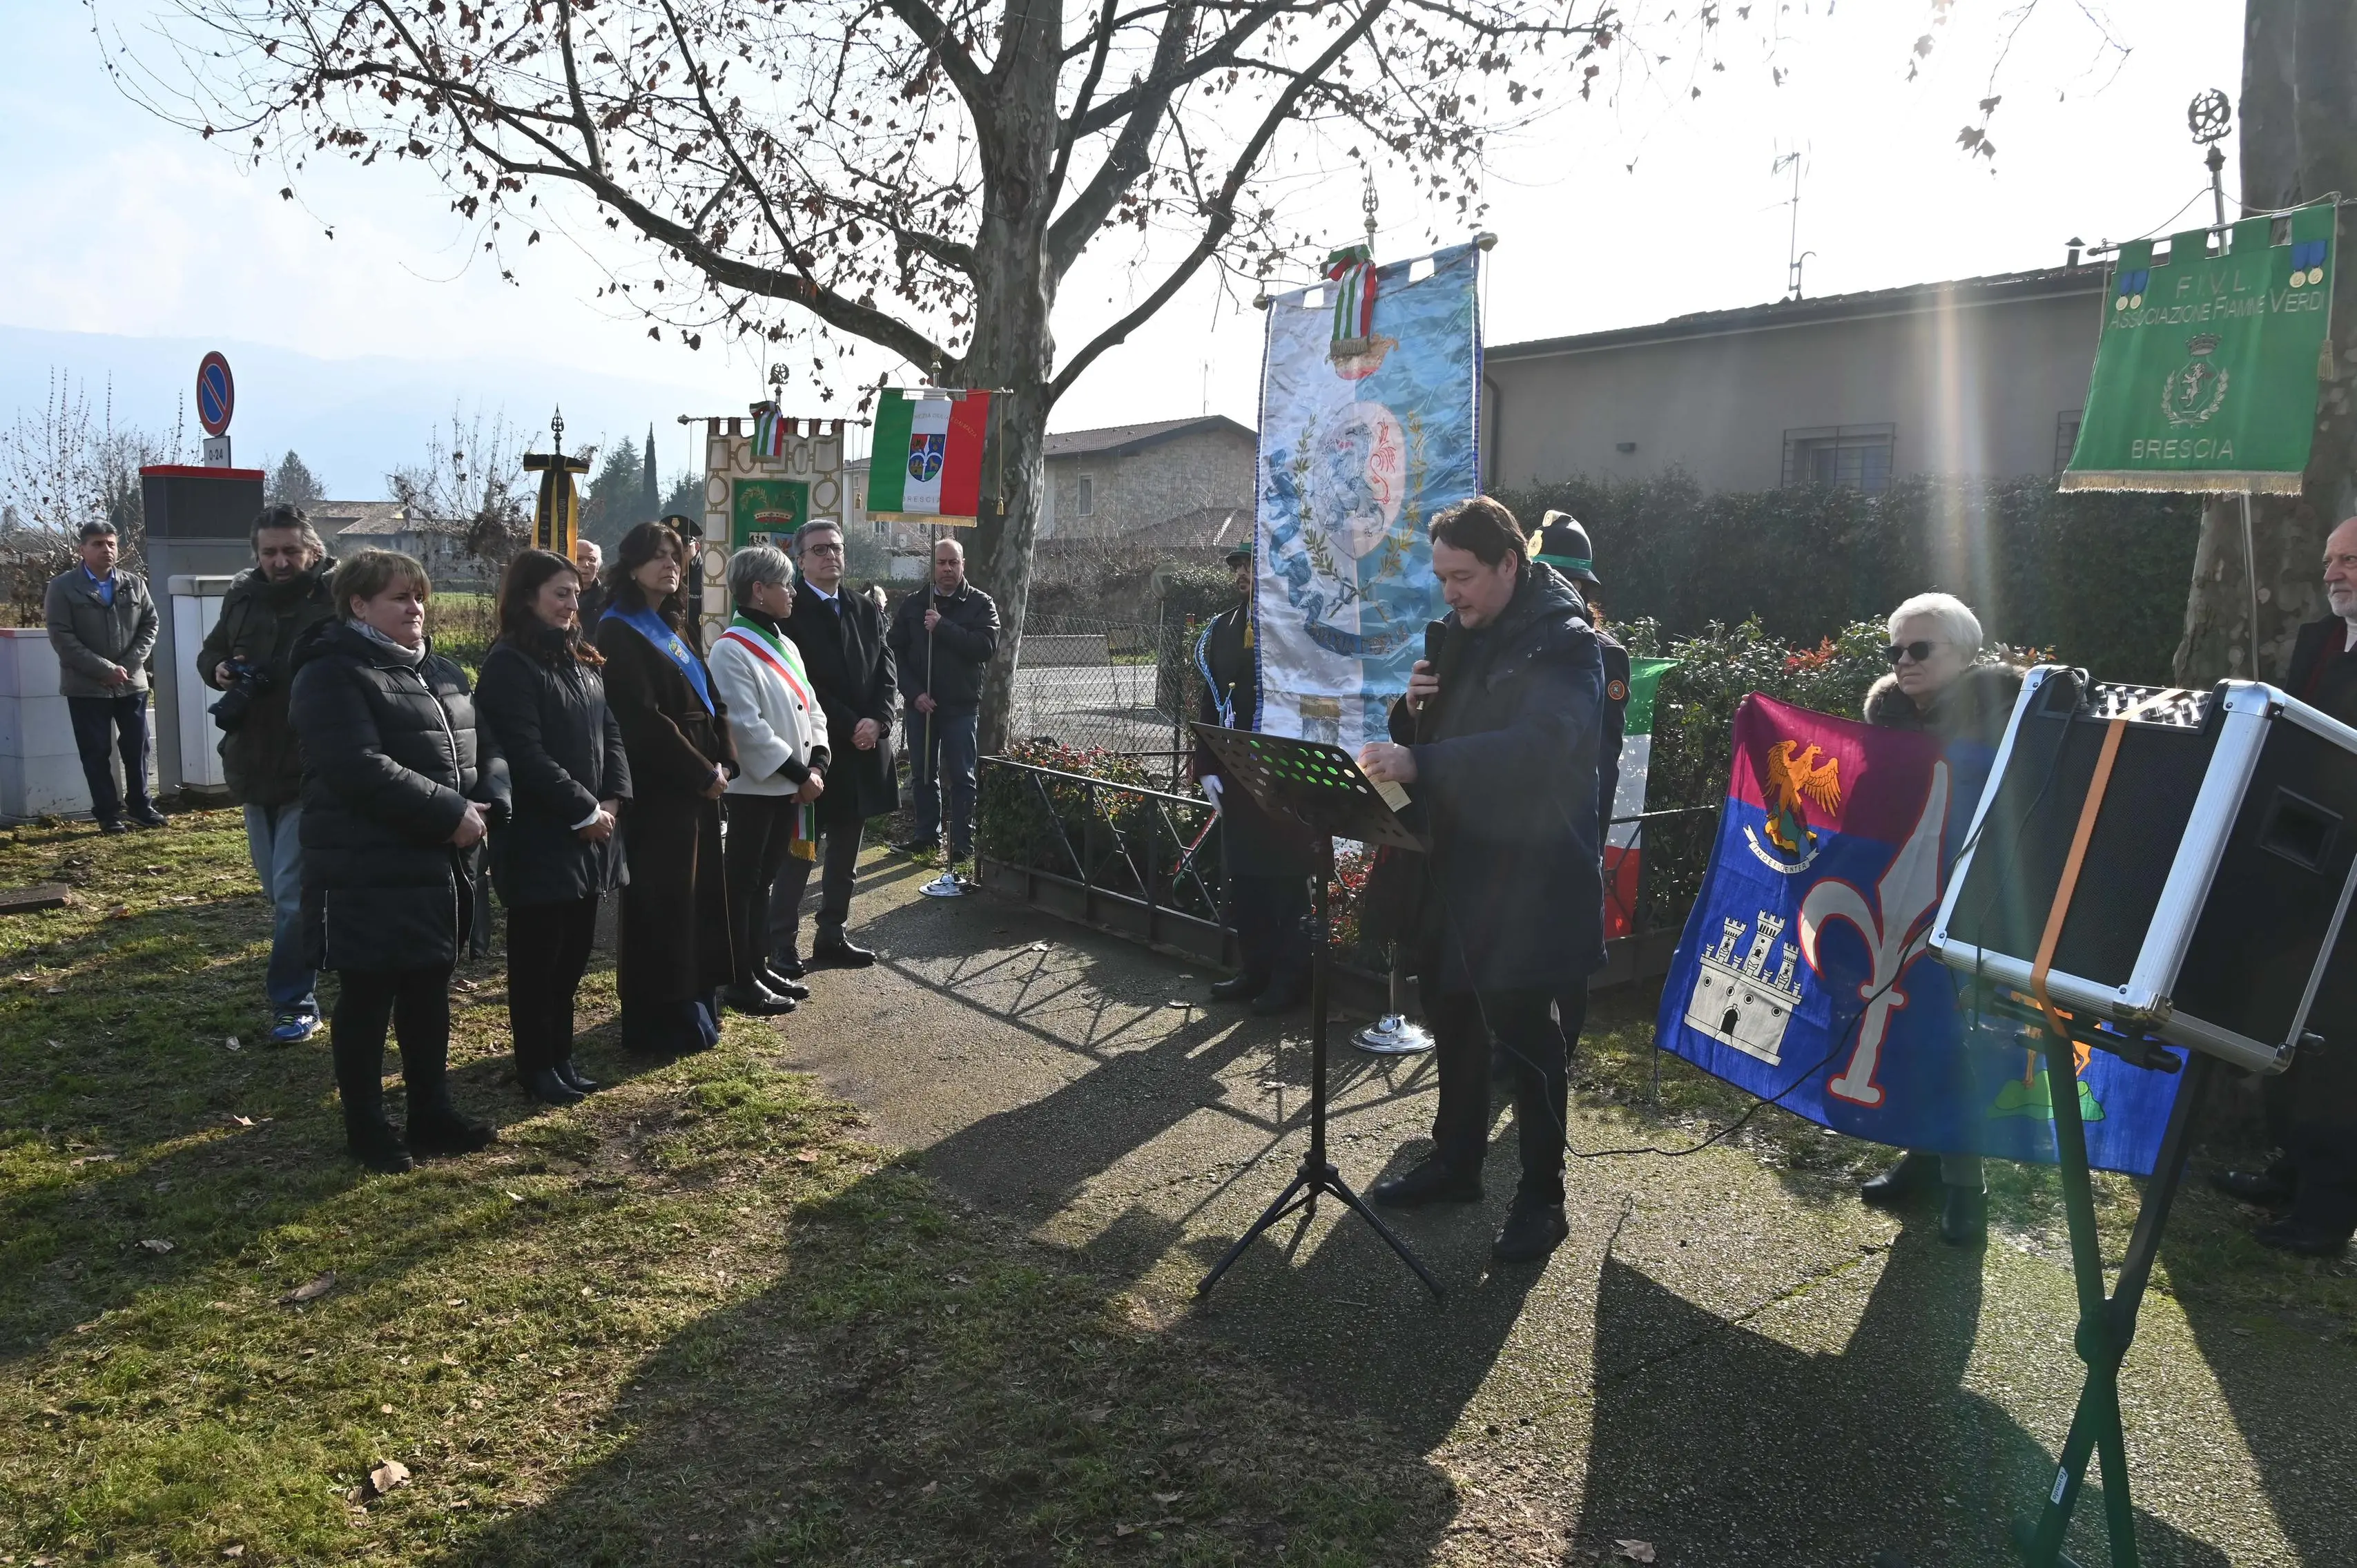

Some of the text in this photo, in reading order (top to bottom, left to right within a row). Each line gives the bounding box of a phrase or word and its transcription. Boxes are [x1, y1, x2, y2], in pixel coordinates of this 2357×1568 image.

[2107, 302, 2212, 330] ASSOCIAZIONE
[2269, 288, 2325, 313] VERDI
[208, 448, 223, 461] 0-24
[2131, 438, 2234, 461] BRESCIA
